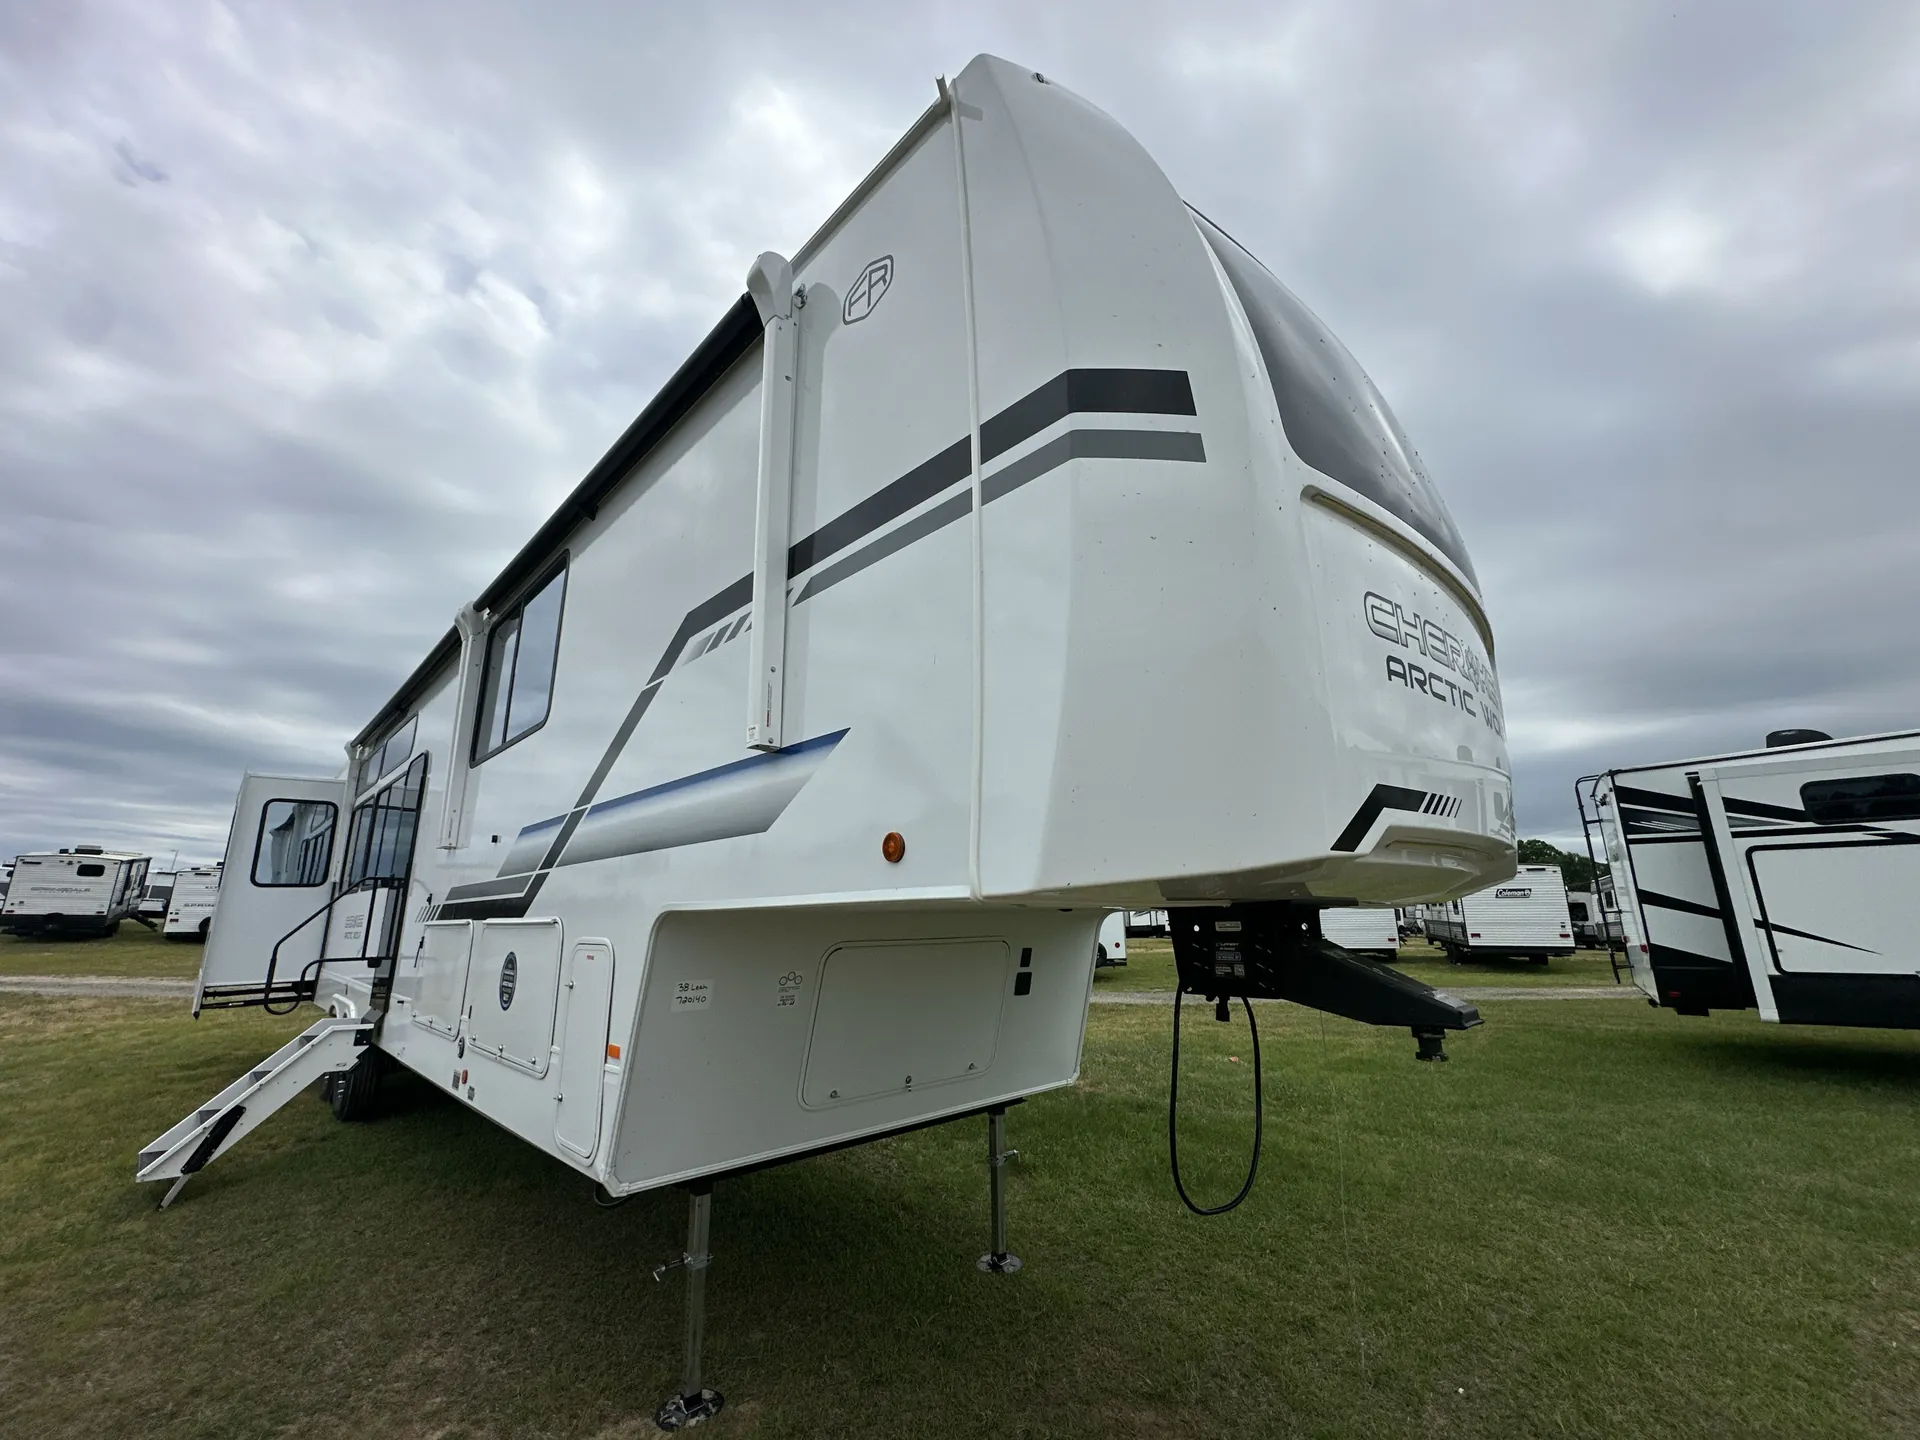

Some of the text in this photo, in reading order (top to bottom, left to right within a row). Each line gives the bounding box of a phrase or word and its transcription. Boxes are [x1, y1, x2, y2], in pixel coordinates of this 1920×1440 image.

[1386, 655, 1477, 718] ARCTIC
[1497, 889, 1525, 897] Coleman
[677, 982, 690, 992] 38
